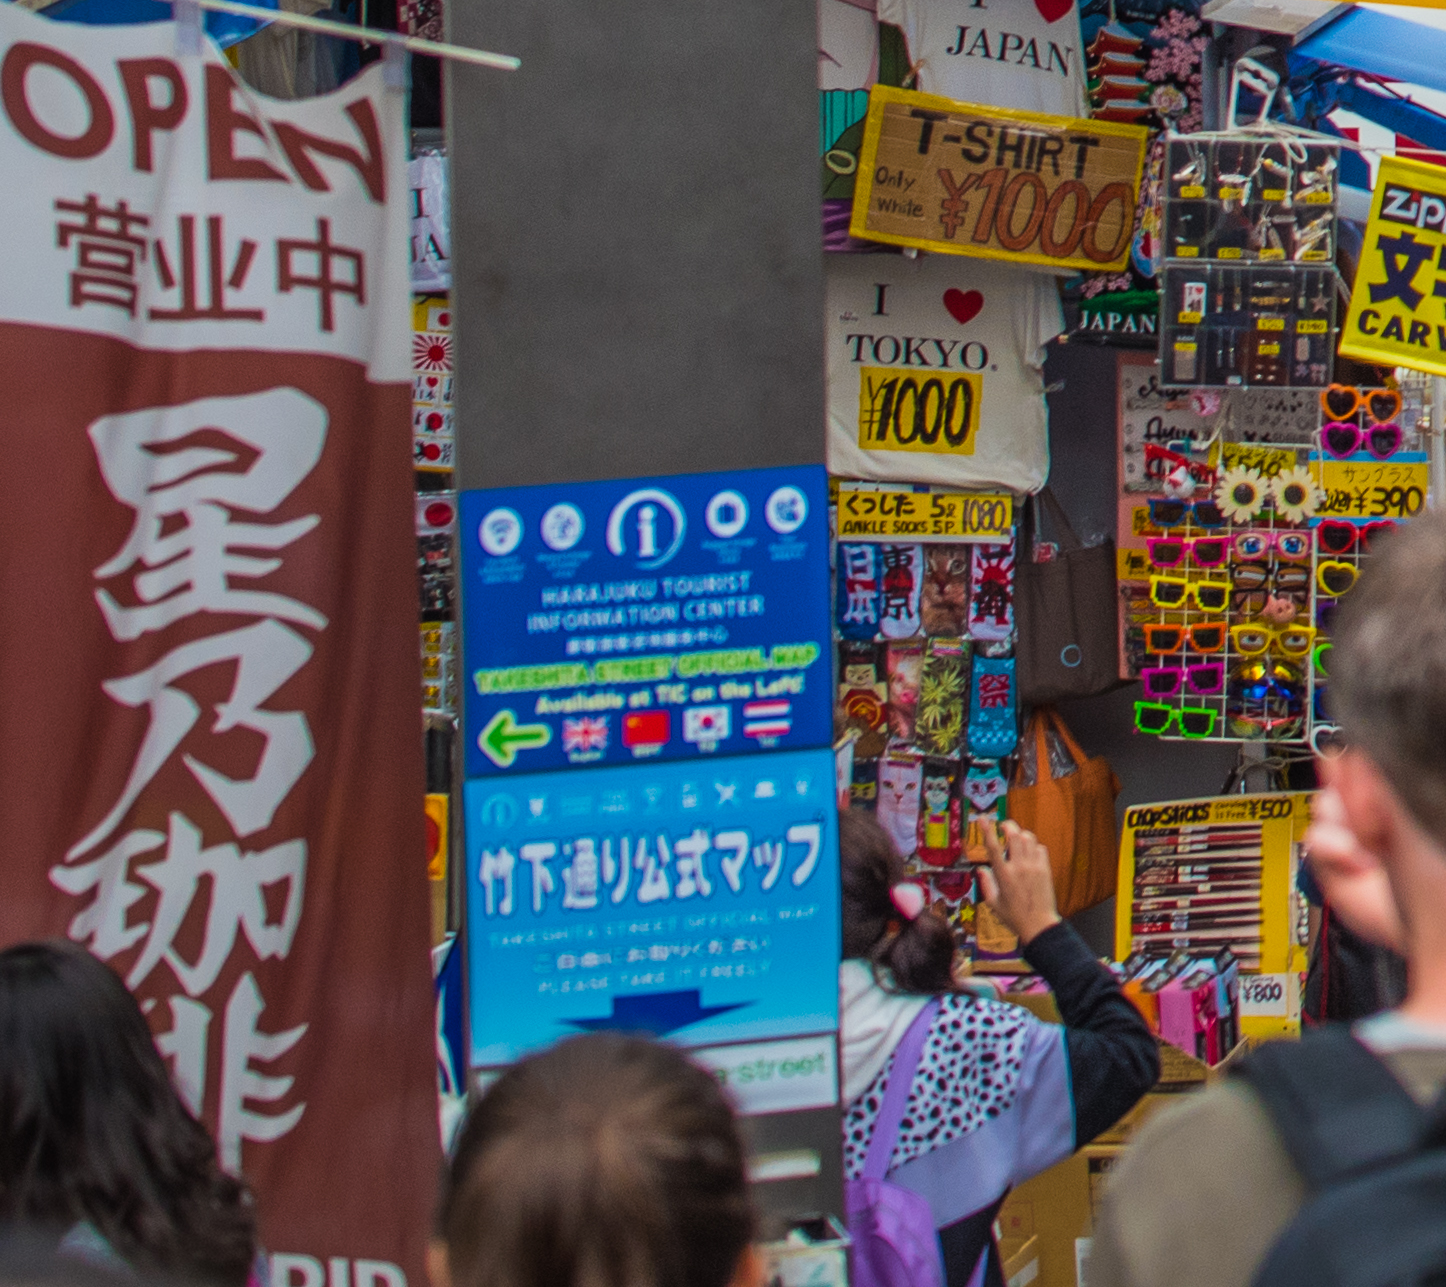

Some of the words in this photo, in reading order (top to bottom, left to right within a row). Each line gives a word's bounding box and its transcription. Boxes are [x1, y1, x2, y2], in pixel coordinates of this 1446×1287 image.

[946, 26, 1076, 78] JAPAN
[2, 38, 389, 208] OPEN
[909, 108, 1098, 179] T-SHIRT
[874, 164, 917, 194] Only
[938, 166, 1137, 261] ¥1000
[50, 181, 372, 355] 営業中
[864, 376, 973, 446] ¥1000
[844, 494, 916, 517] くつした
[527, 606, 678, 634] INFORMATION
[684, 595, 766, 621] CENTER
[541, 582, 655, 608] HARAJUKU
[661, 571, 754, 600] TOURIST
[1247, 796, 1293, 820] ¥500
[480, 822, 824, 918] 竹下通り公式マップ
